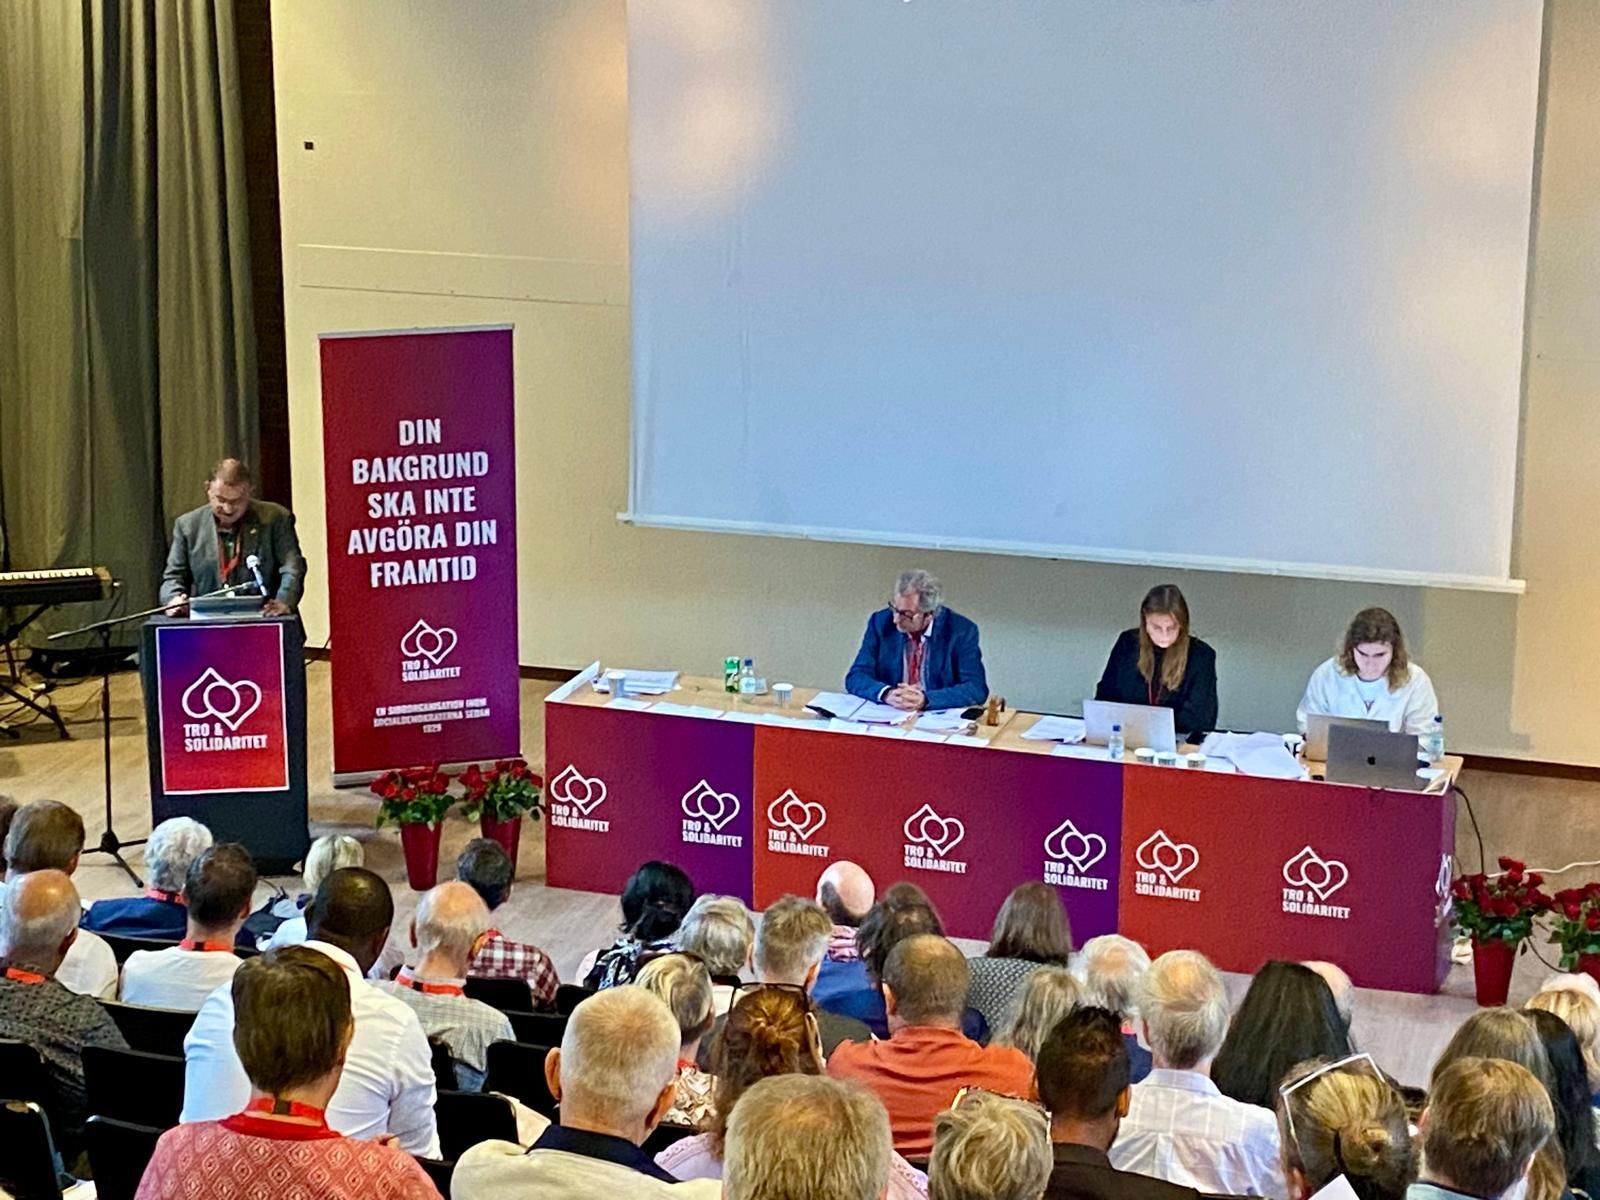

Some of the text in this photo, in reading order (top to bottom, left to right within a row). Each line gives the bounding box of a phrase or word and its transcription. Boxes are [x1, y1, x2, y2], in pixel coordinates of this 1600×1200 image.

[398, 418, 442, 446] DIN
[352, 451, 489, 485] BAKGRUND
[367, 486, 477, 519] SKA INTE
[347, 519, 497, 555] AVGÖRA DIN
[370, 555, 478, 588] FRAMTID
[401, 660, 421, 671] TRO
[401, 666, 461, 682] SOLIDARITET
[183, 722, 224, 737] TRO &
[184, 735, 267, 752] SOLIDARITET
[551, 804, 579, 817] TRO &
[551, 816, 609, 832] SOLIDARITET
[682, 819, 711, 832] TRO &
[682, 831, 742, 847] SOLIDARITET
[768, 829, 797, 842] TRO &
[768, 841, 829, 857] SOLIDARITET
[904, 844, 934, 858] TRO &
[904, 857, 966, 873] SOLIDARITET
[1044, 861, 1075, 874] TRO &
[1044, 872, 1108, 889] SOLIDARITET
[1135, 871, 1167, 885] TRO &
[1135, 883, 1200, 901] SOLIDARITET
[1282, 888, 1315, 902] TRO &
[1282, 901, 1350, 918] SOLIDARITET
